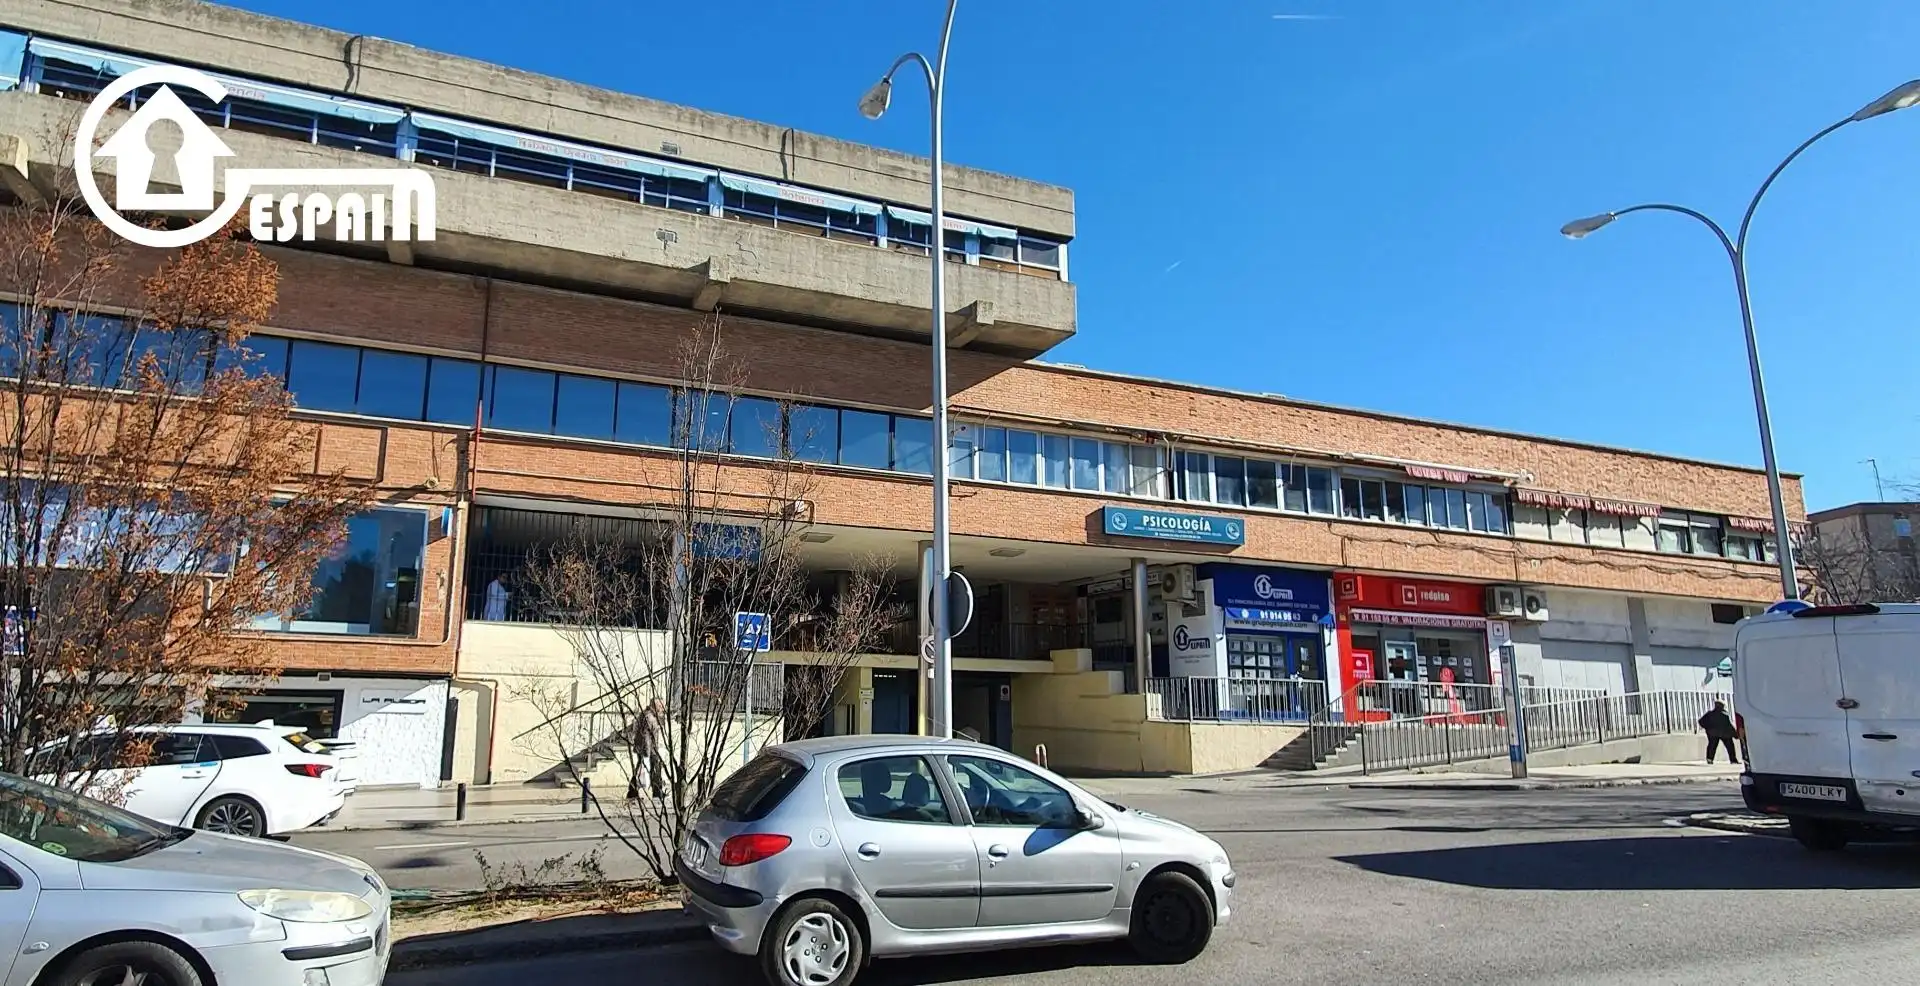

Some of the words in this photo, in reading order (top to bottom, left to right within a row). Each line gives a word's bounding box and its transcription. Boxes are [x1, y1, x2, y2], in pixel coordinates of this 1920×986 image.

[1142, 514, 1212, 533] PSICOLOGÍA
[1787, 783, 1817, 796] 5400
[1819, 786, 1843, 798] LKY
